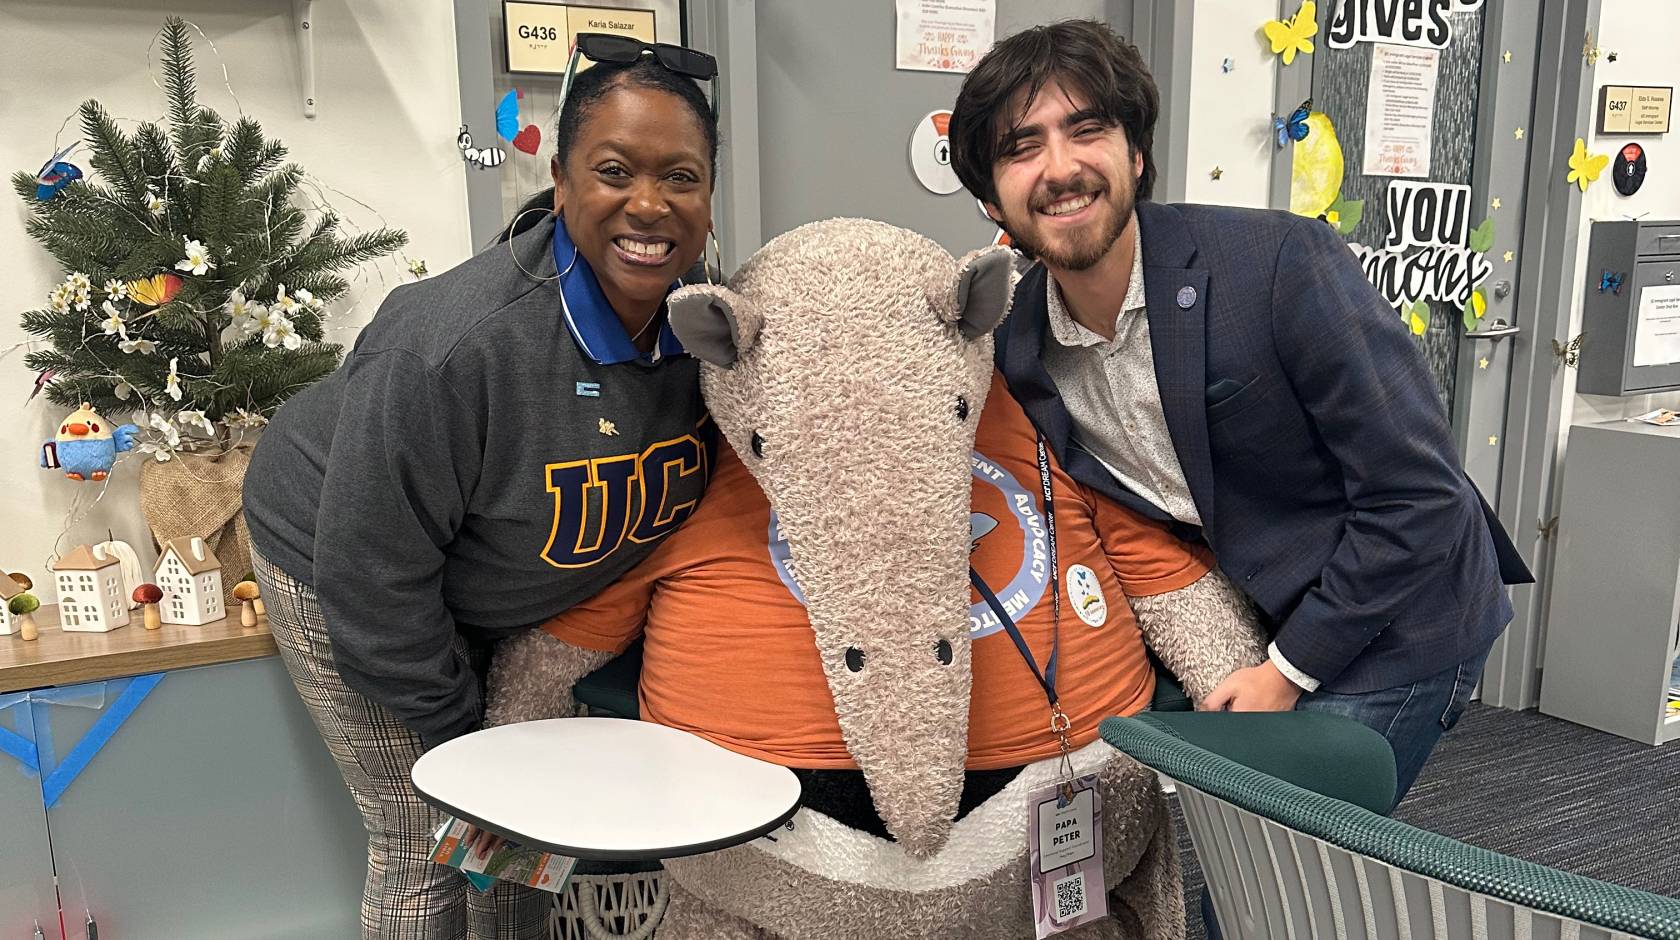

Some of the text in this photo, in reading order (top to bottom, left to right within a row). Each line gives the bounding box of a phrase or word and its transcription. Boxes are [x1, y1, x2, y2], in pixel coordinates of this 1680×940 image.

[608, 20, 635, 30] Salazar
[1330, 0, 1450, 45] gives
[518, 25, 557, 41] G436
[1609, 101, 1627, 111] G437
[1387, 187, 1467, 246] you
[1040, 461, 1051, 486] DREAM
[1055, 817, 1077, 831] PAPA
[1053, 830, 1081, 847] PETER
